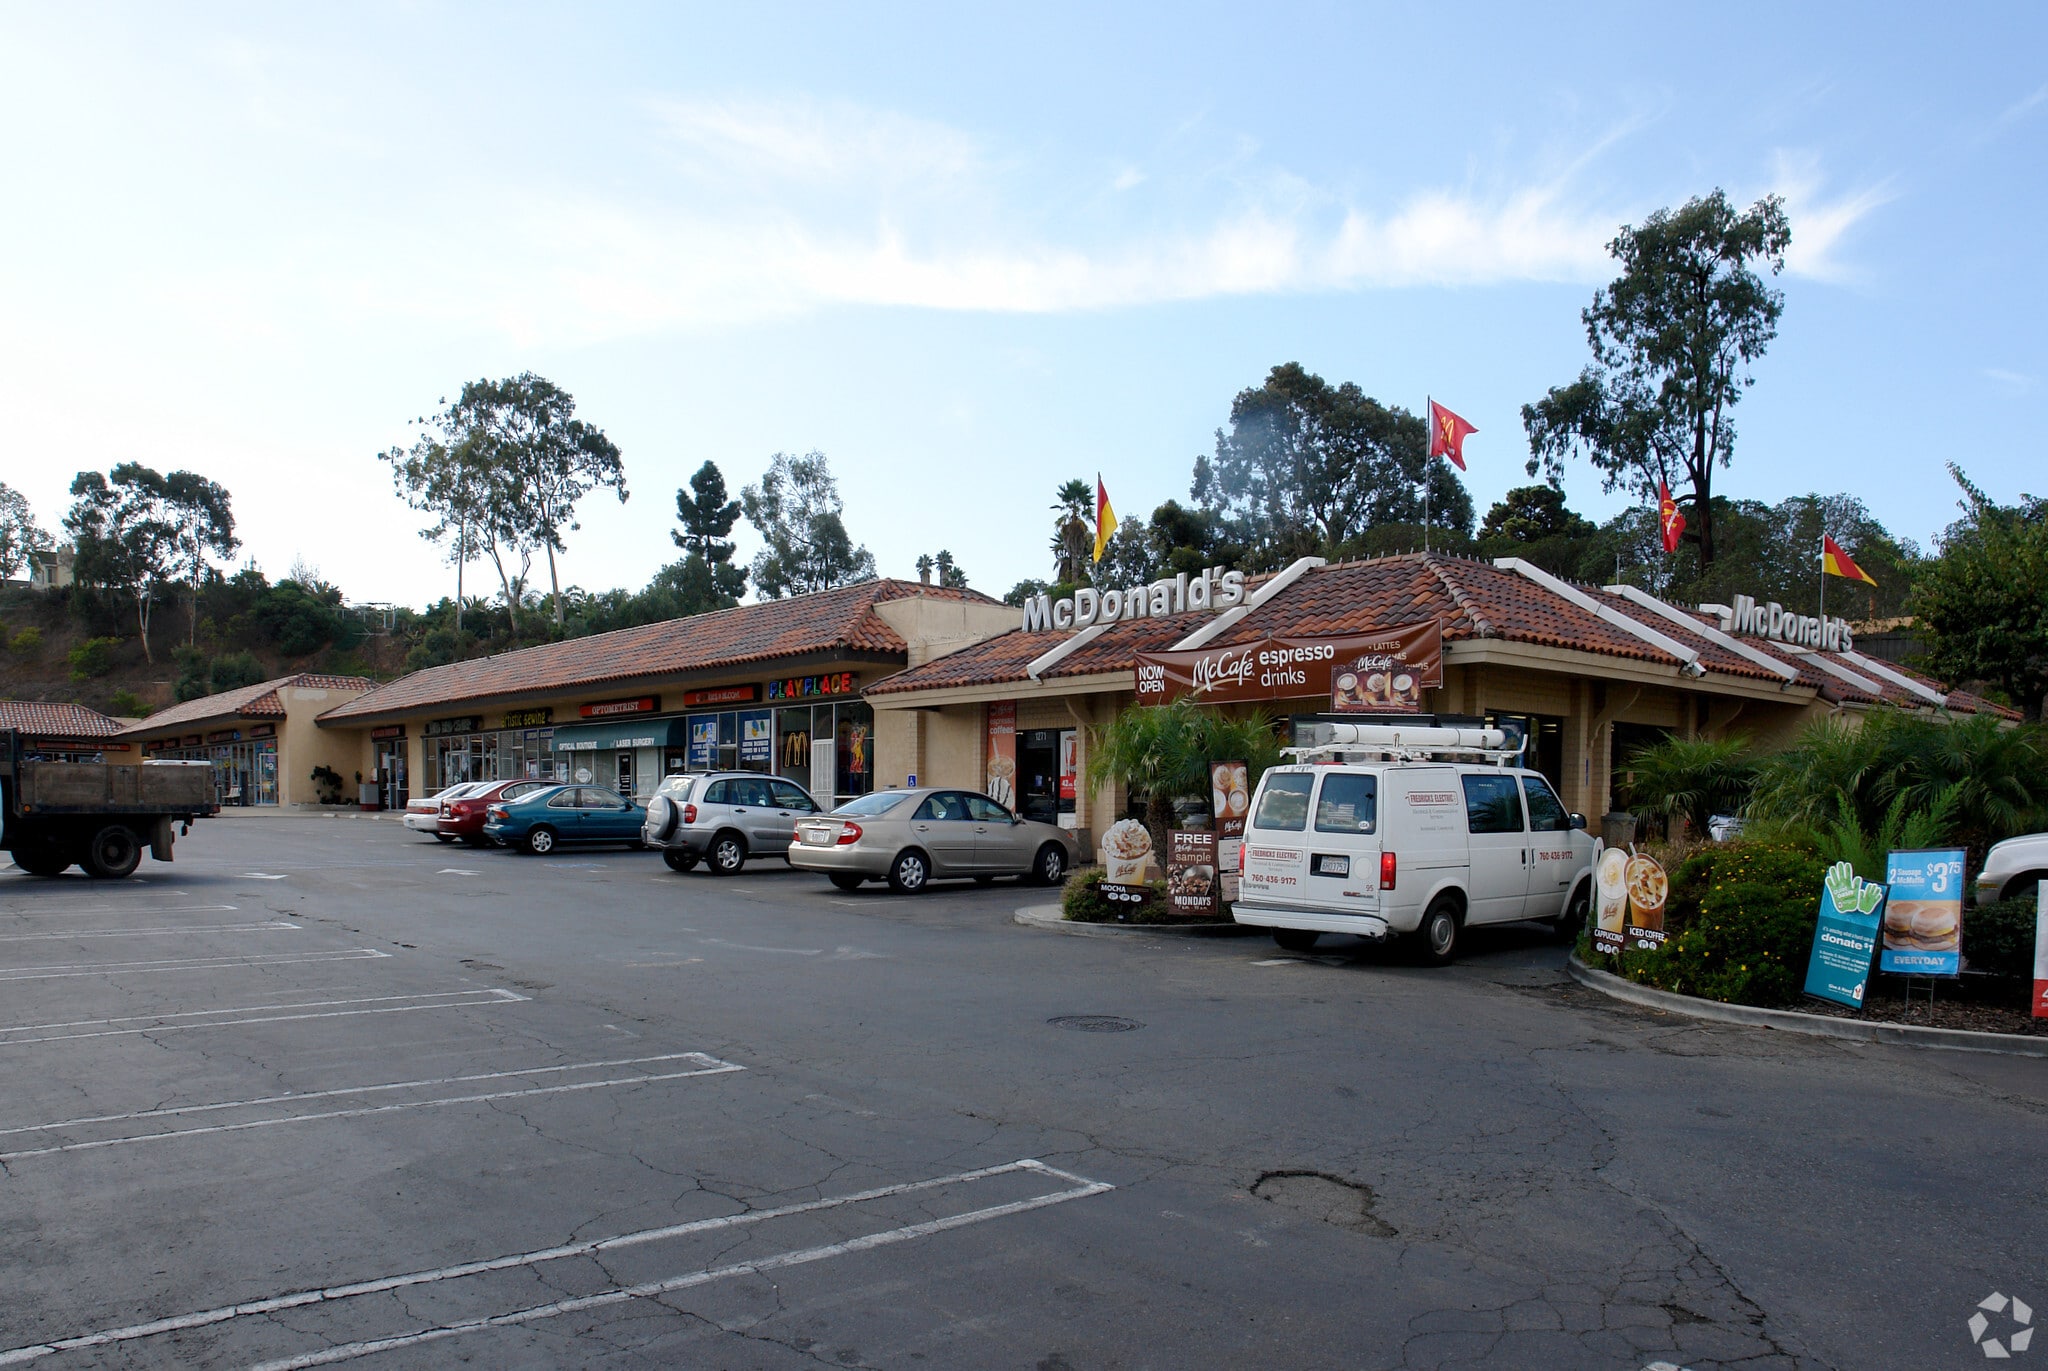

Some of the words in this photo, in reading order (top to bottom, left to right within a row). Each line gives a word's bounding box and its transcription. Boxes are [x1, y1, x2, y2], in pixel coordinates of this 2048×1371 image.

[1022, 565, 1245, 632] McDonald's
[1731, 594, 1853, 653] McDonald's
[1373, 640, 1400, 651] LATTES
[1258, 645, 1334, 667] espresso
[1192, 650, 1254, 692] McCafé
[1357, 655, 1393, 673] McCafé
[1138, 666, 1165, 681] NOW
[1260, 667, 1306, 687] drinks
[769, 673, 851, 700] PLAYPLACE
[1139, 680, 1165, 693] OPEN
[591, 701, 640, 715] OPTOMETRIST
[558, 742, 576, 750] OPTICAL
[576, 741, 598, 750] BOUTIQUE
[616, 739, 631, 747] LASER
[632, 737, 655, 746] SURGERY
[1174, 833, 1212, 845] FREE
[1175, 852, 1212, 864] sample
[1276, 851, 1297, 860] ELECTRIC
[1889, 868, 1897, 884] 2
[1897, 869, 1922, 878] Sausage
[1101, 883, 1127, 893] MOCHA
[1174, 894, 1212, 907] MONDAYS
[1594, 929, 1624, 943] CAPPUCCINO
[1629, 927, 1645, 937] ICED
[1645, 929, 1665, 942] COFFEE
[1821, 933, 1863, 950] donate
[1893, 955, 1946, 966] EVERYDAY
